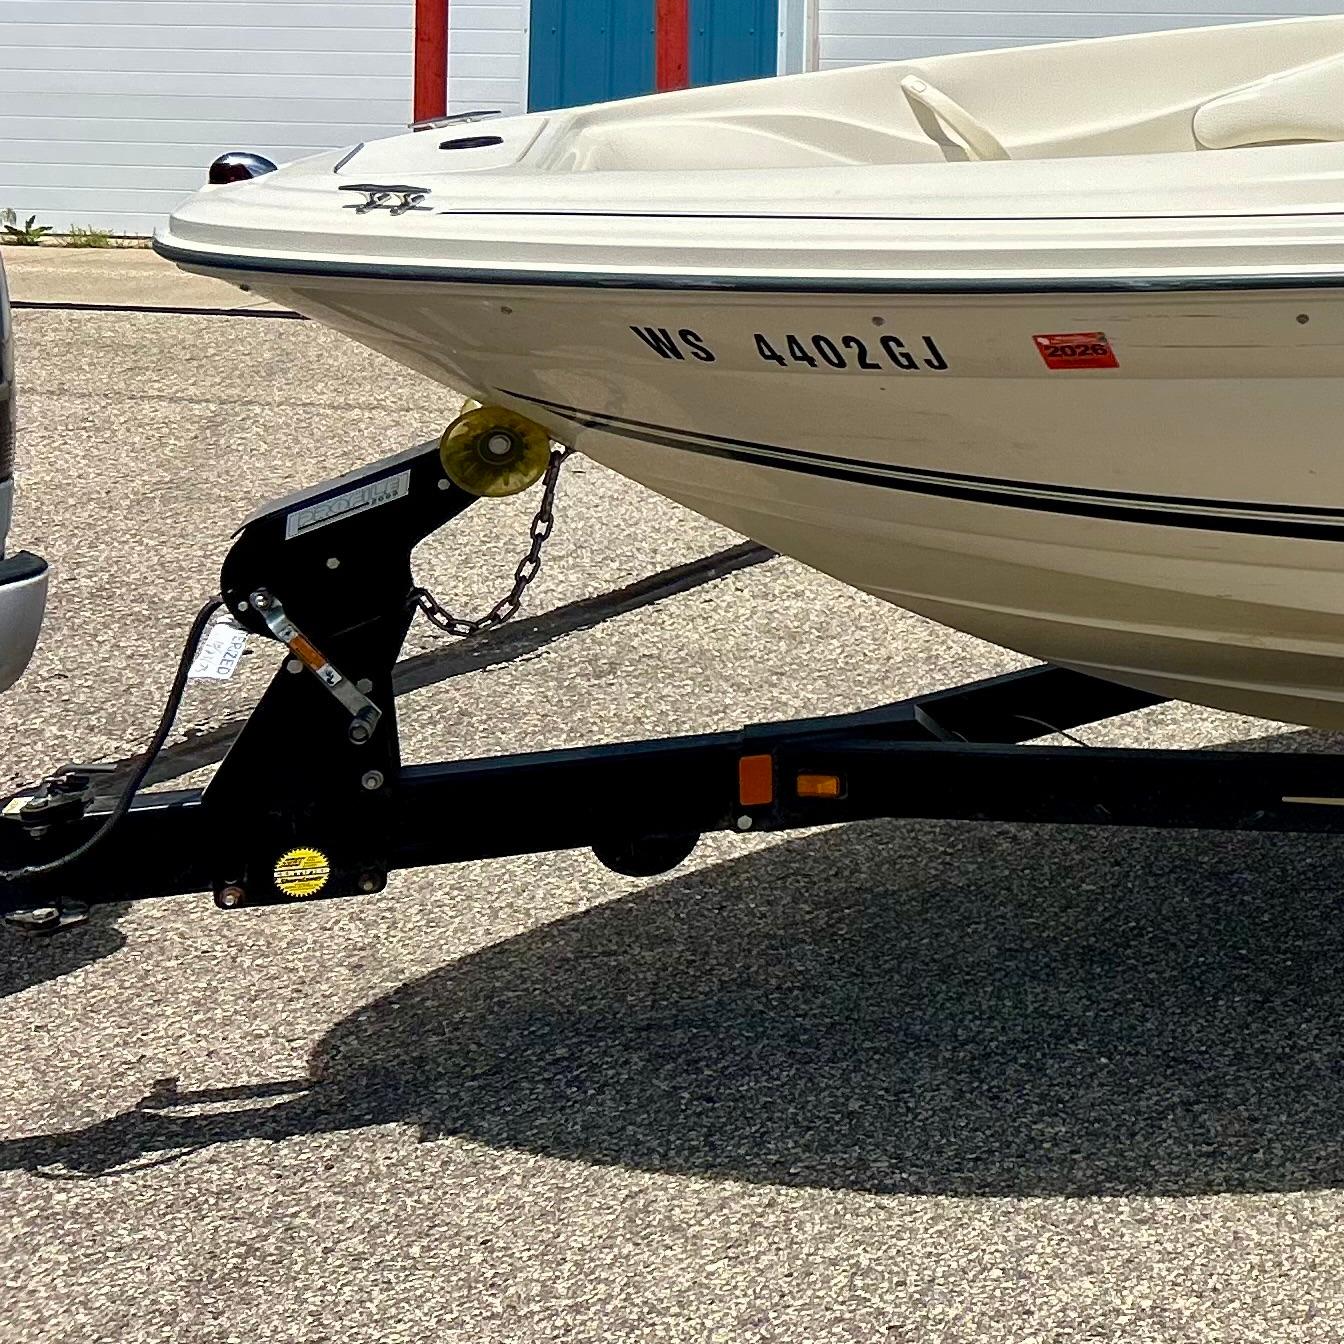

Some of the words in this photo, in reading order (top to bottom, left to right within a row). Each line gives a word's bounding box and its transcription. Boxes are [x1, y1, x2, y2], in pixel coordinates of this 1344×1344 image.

[630, 326, 716, 362] WS
[753, 333, 949, 370] 4402GJ
[1044, 344, 1108, 357] 2026
